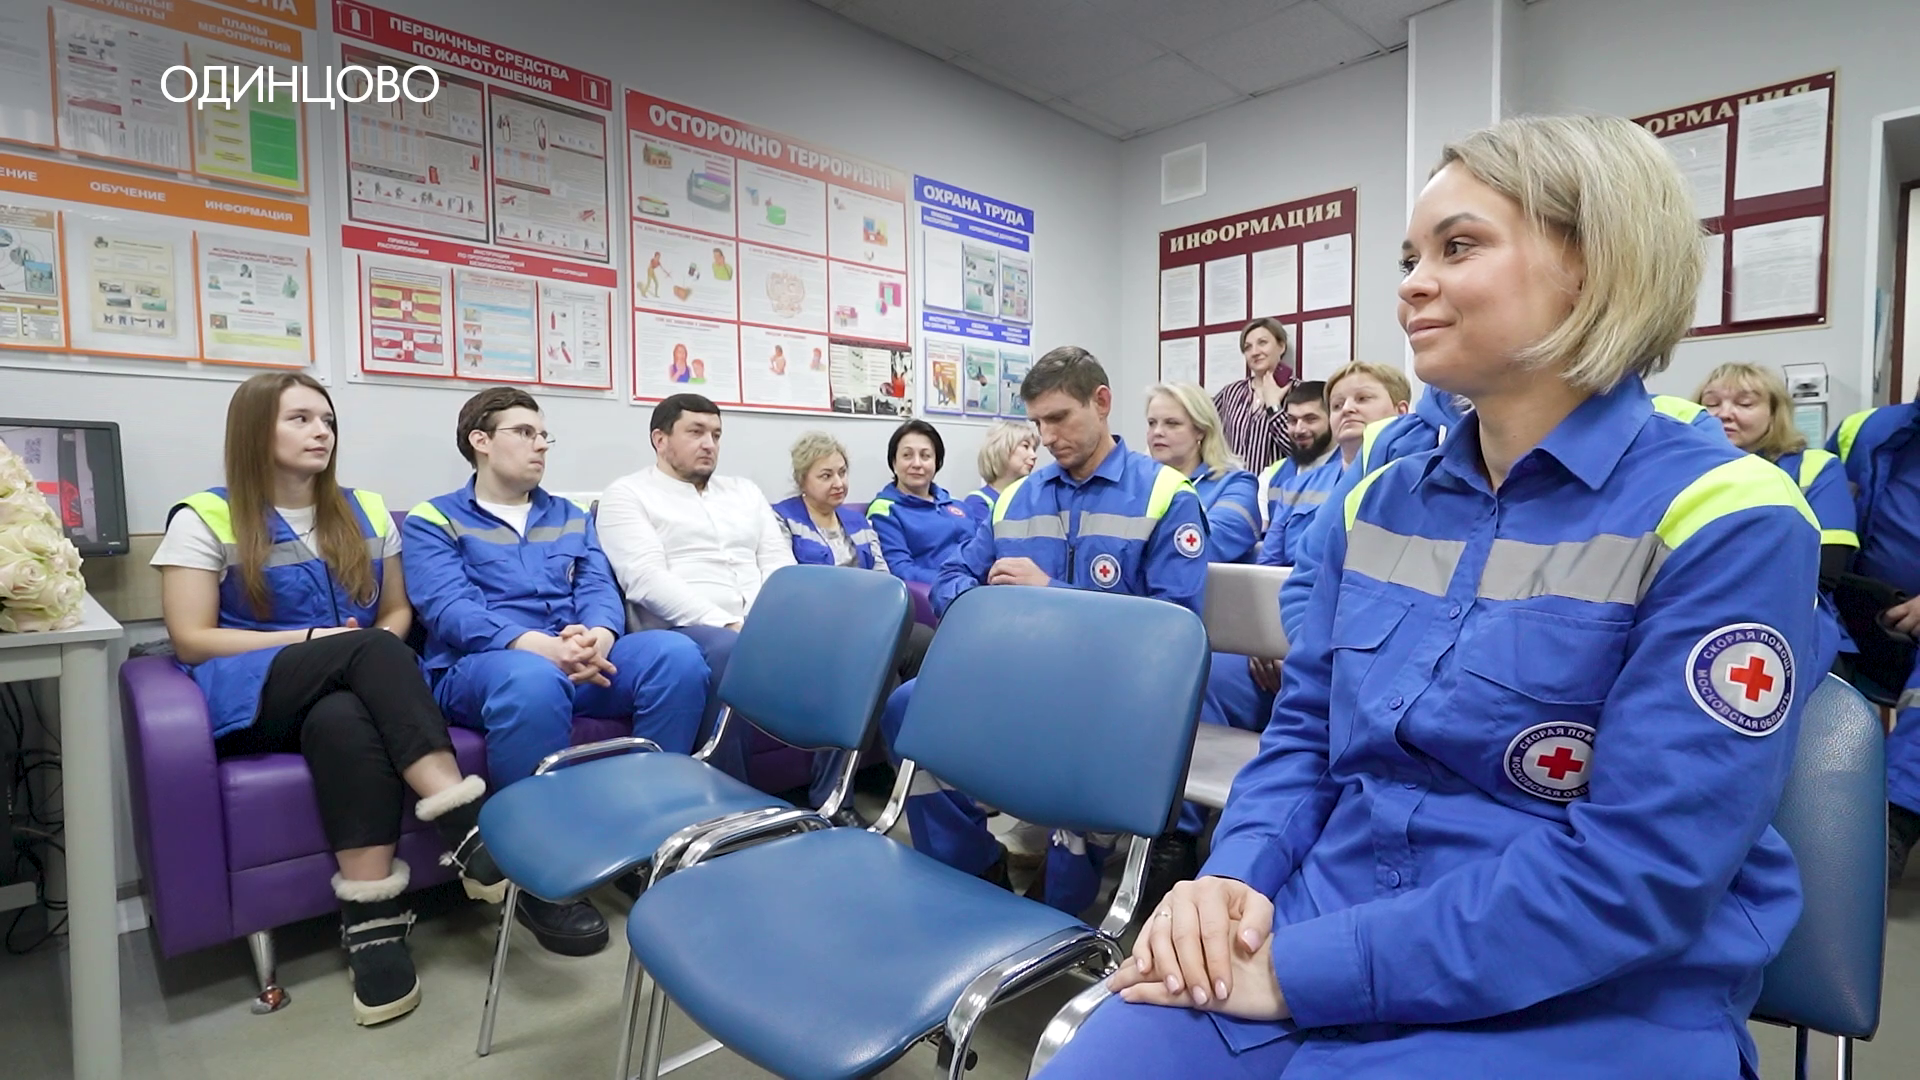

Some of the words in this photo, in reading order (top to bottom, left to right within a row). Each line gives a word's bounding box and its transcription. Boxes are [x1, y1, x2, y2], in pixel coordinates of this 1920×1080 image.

[198, 21, 291, 53] МЕРОПРИЯТИЙ
[222, 16, 268, 37] ПЛАНЫ
[389, 16, 492, 58] ПЕРВИЧНЫЕ
[494, 44, 570, 81] СРЕДСТВА
[412, 40, 552, 92] ПОЖАРОТУШЕНИЯ
[649, 104, 782, 160] ОСТОРОЖНО
[787, 143, 892, 192] ТЕРРОРИЗМ!
[90, 181, 167, 202] ОБУЧЕНИЕ
[205, 200, 294, 222] ИНФОРМАЦИЯ
[923, 185, 981, 214] ОХРАНА
[983, 202, 1026, 226] ТРУДА
[1169, 200, 1343, 253] ИНФОРМАЦИЯ
[1703, 631, 1756, 659] СКОРАЯ
[1760, 632, 1791, 677] ПОМОЩЬ
[1697, 669, 1759, 729] МОСКОВСКАЯ
[1760, 692, 1791, 729] ОБЛАСТЬ
[1520, 727, 1565, 750] СКОРАЯ
[1567, 728, 1595, 744] ПОМ
[1511, 756, 1561, 798] МОСКОВСКАЯ
[1563, 786, 1589, 798] ОБЛ
